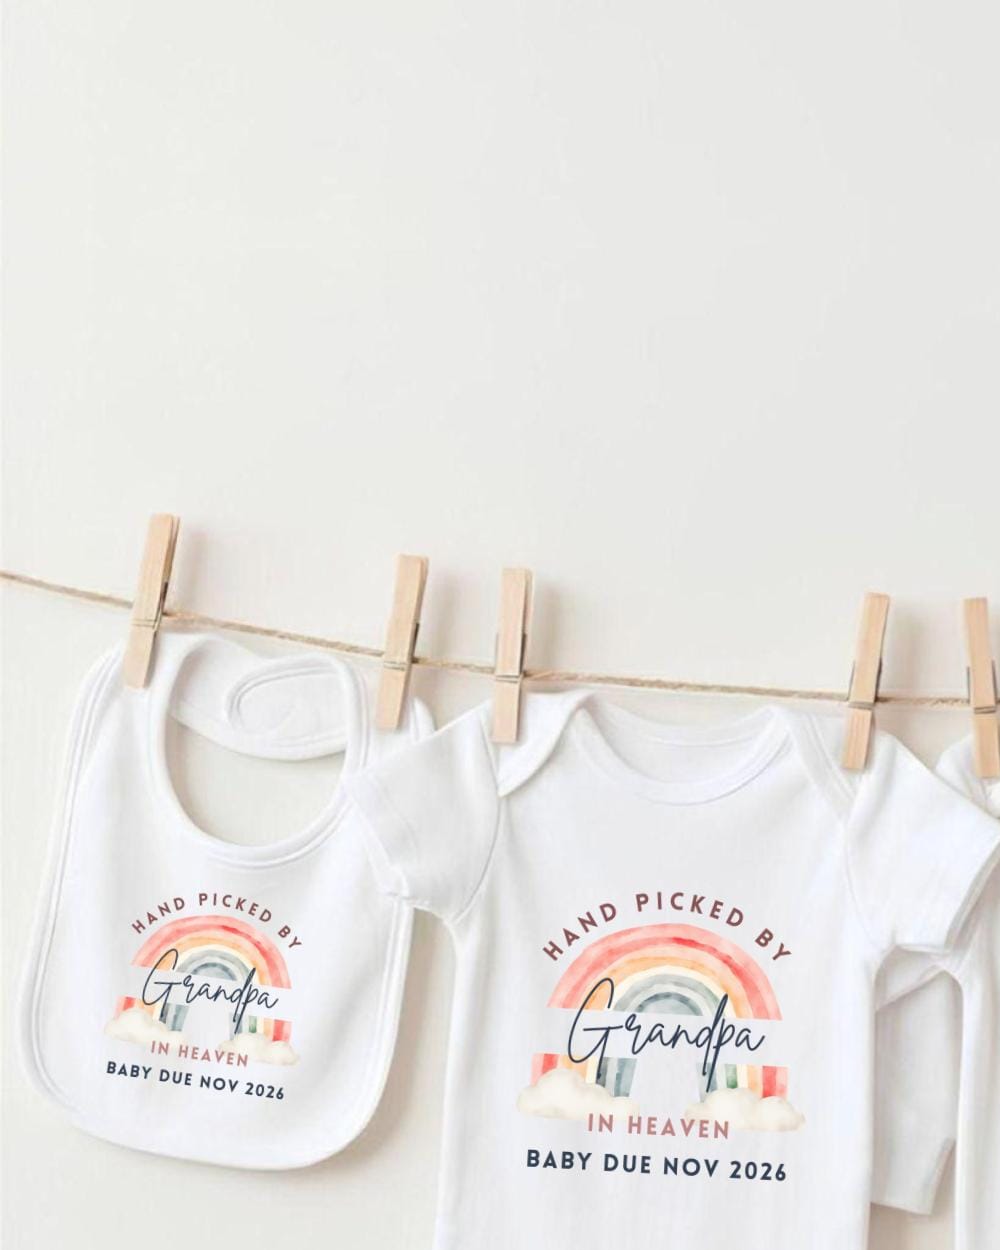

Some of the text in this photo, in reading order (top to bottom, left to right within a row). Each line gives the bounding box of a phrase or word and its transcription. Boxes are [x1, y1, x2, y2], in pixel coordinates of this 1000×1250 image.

[132, 893, 302, 950] HAND PICKED BY
[542, 892, 792, 961] HAND PICKED BY
[142, 948, 279, 1034] Grandpa
[151, 1041, 248, 1067] IN HEAVEN
[568, 978, 765, 1092] Grandpa
[106, 1061, 284, 1100] BABY DUE NOV 2026
[588, 1113, 729, 1139] IN HEAVEN
[527, 1149, 786, 1181] BABY DUE NOV 2026
